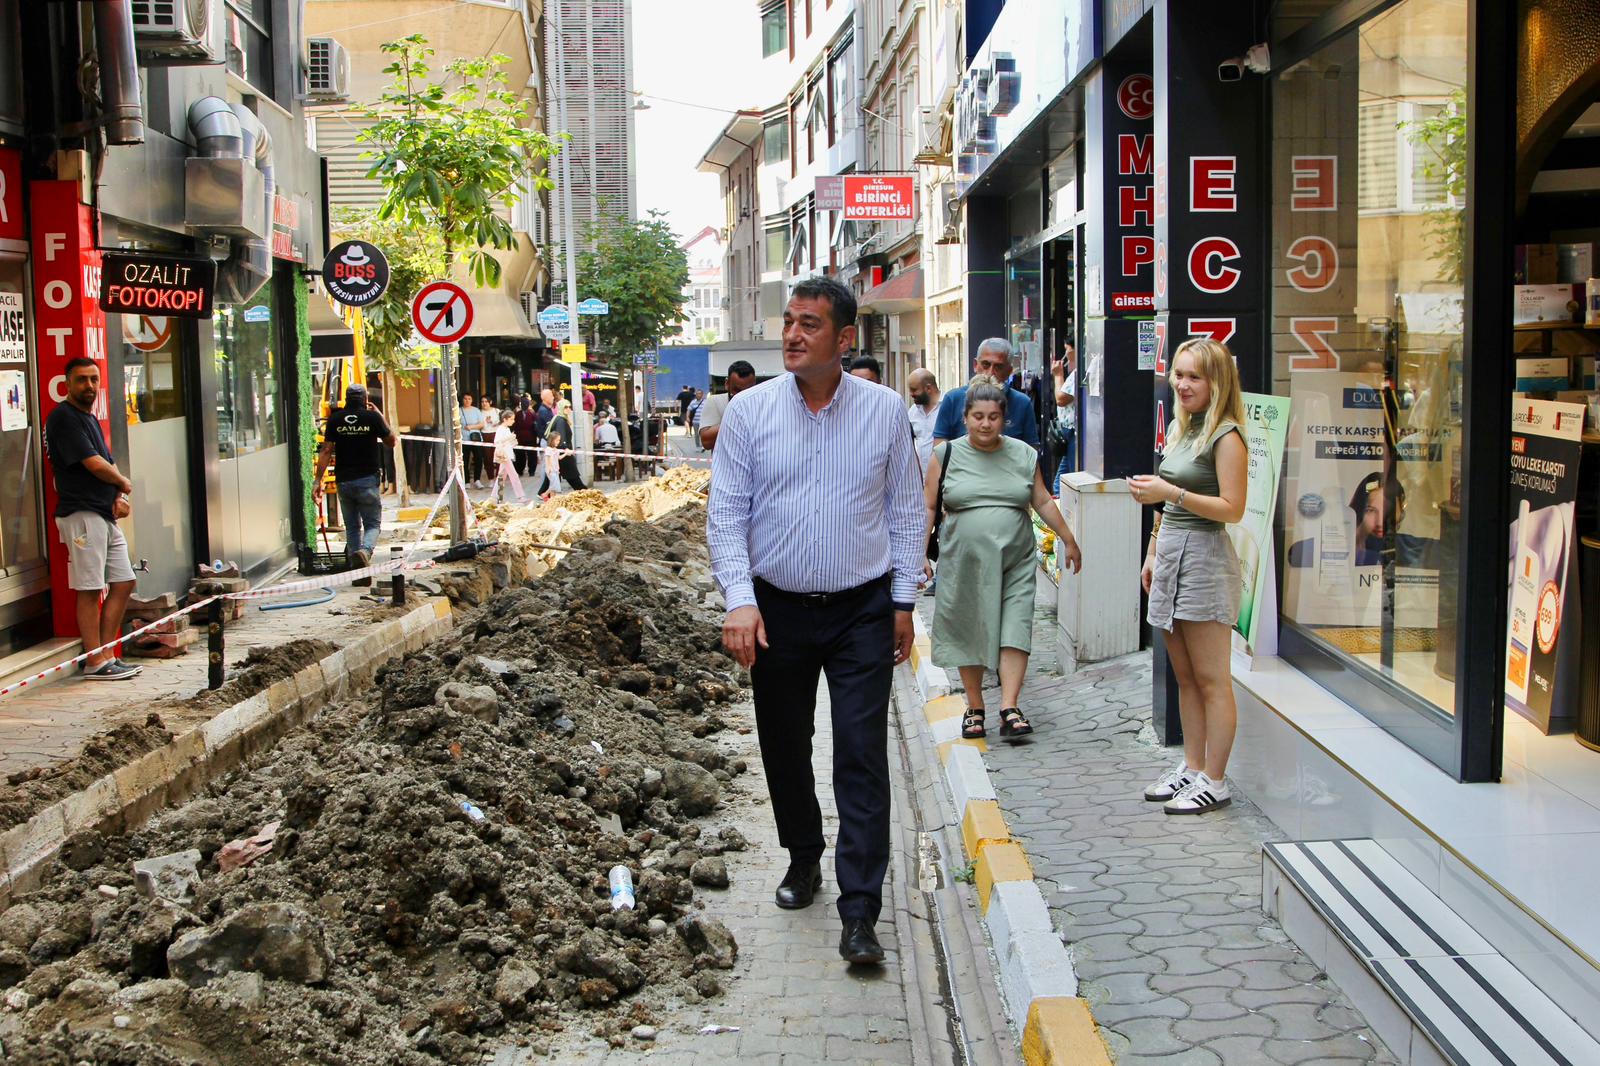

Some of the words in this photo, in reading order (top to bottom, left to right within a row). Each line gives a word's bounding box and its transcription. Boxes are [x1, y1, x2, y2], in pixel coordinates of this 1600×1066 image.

[855, 191, 901, 203] BİRİNCİ
[846, 204, 911, 217] NOTERLİĞİ
[1118, 134, 1154, 277] MHP
[124, 264, 191, 286] OZALİT
[335, 263, 376, 279] BOSS
[109, 285, 204, 311] FOTOKOPİ
[329, 281, 354, 301] MERSİN
[0, 348, 24, 359] APILIR
[1307, 424, 1342, 435] KEPEK
[1345, 425, 1385, 439] KARŞIT
[1325, 444, 1358, 455] KEPEĞİ
